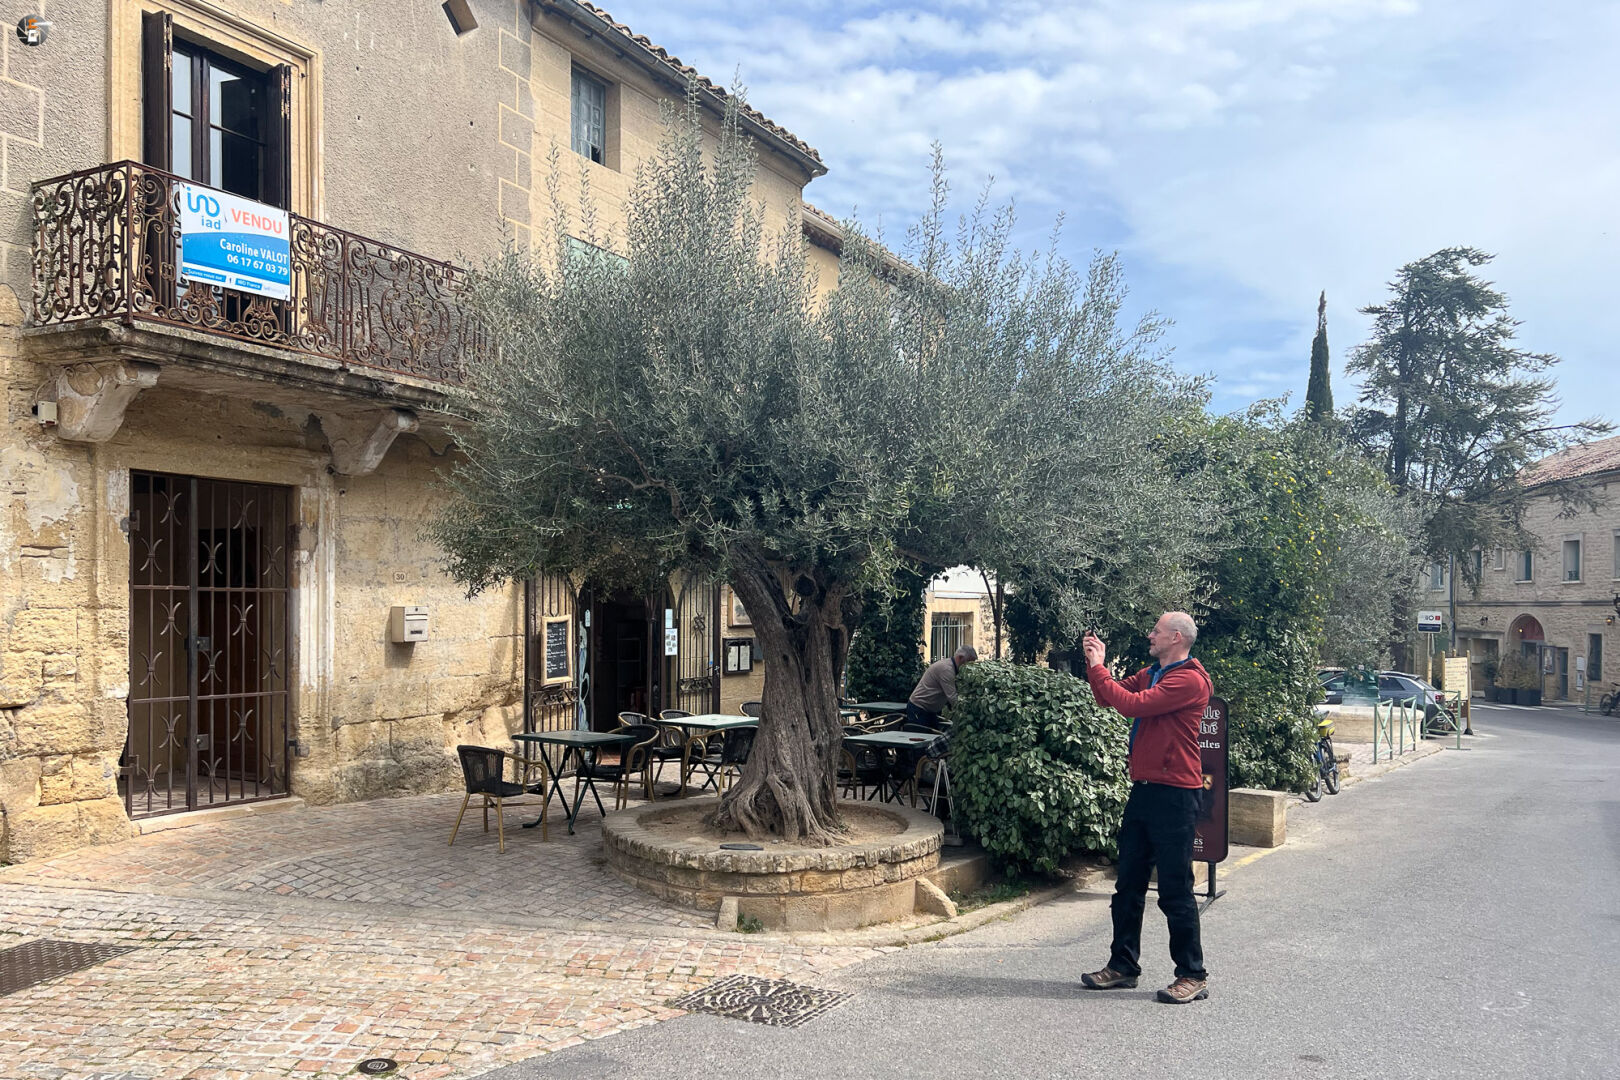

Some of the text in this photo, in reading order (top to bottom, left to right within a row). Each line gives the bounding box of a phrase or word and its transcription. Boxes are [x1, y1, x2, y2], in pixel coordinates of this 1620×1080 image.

[201, 215, 221, 230] iad
[231, 208, 282, 234] VENDU
[220, 238, 287, 265] Caroline VALOT
[227, 254, 288, 276] 06 17 67 03 79
[396, 573, 405, 581] 30
